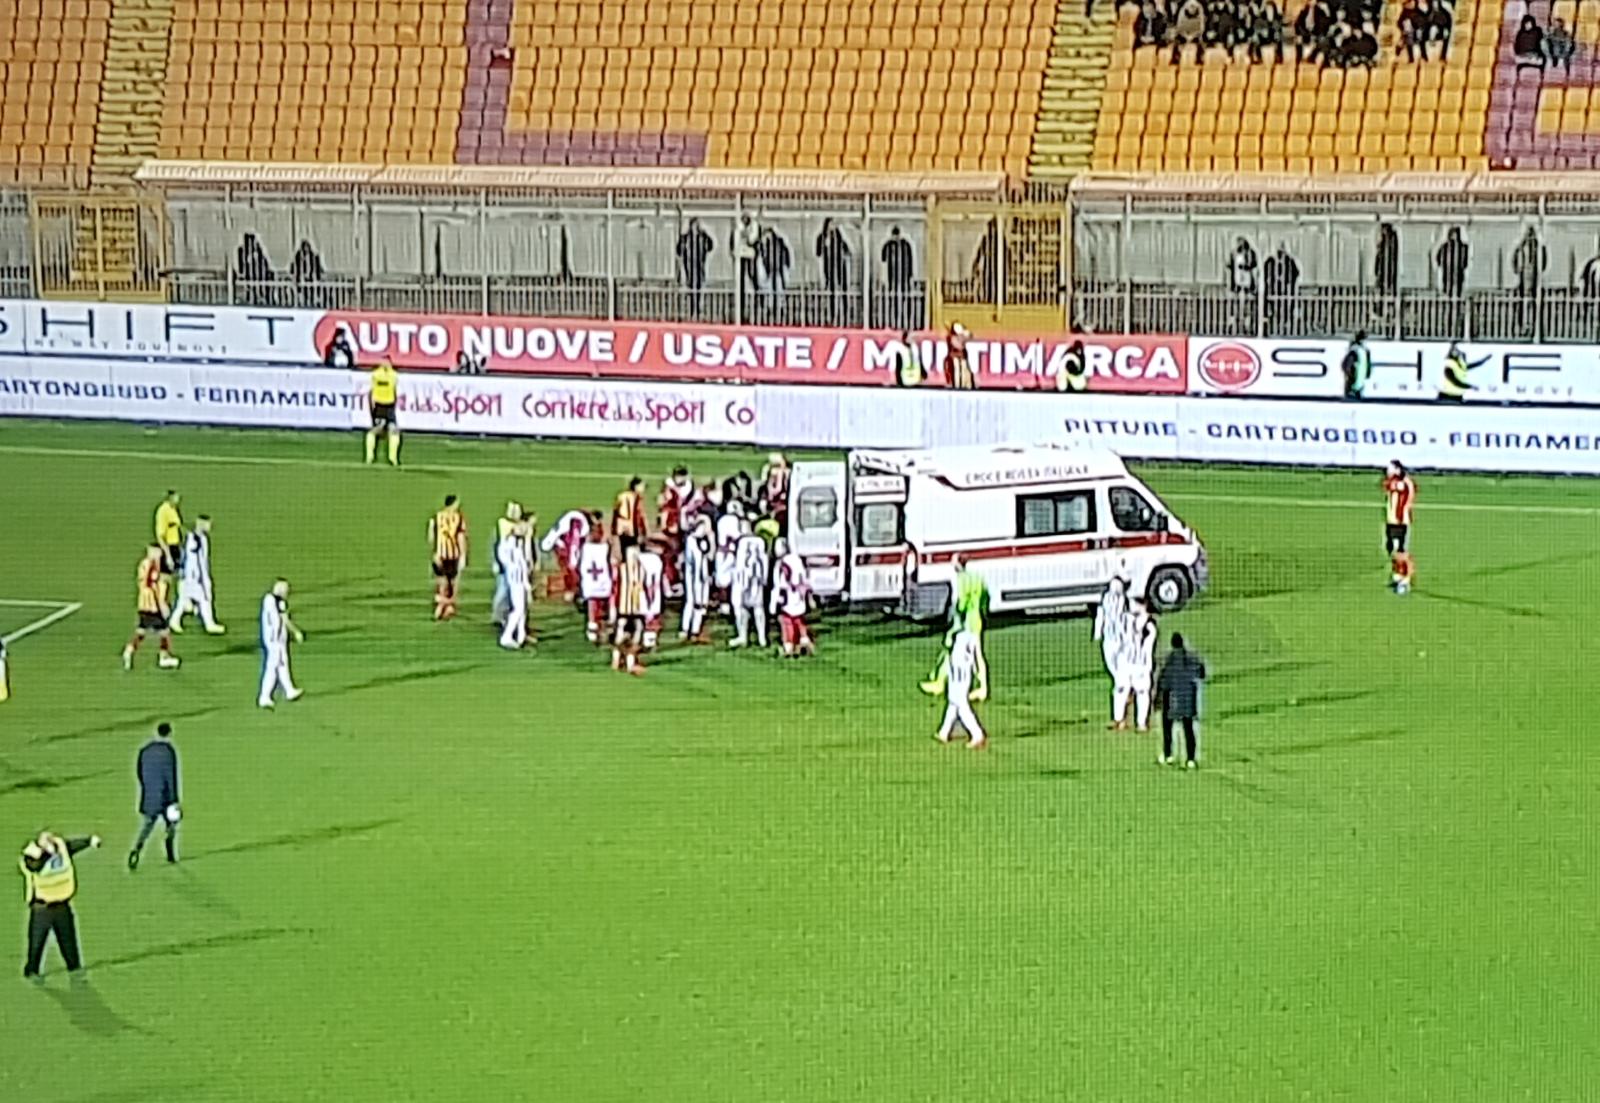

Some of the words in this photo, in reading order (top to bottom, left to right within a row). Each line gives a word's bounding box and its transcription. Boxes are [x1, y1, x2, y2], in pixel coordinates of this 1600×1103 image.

[0, 302, 295, 346] HIFT
[462, 325, 615, 363] NUOVE
[663, 332, 812, 368] USATE
